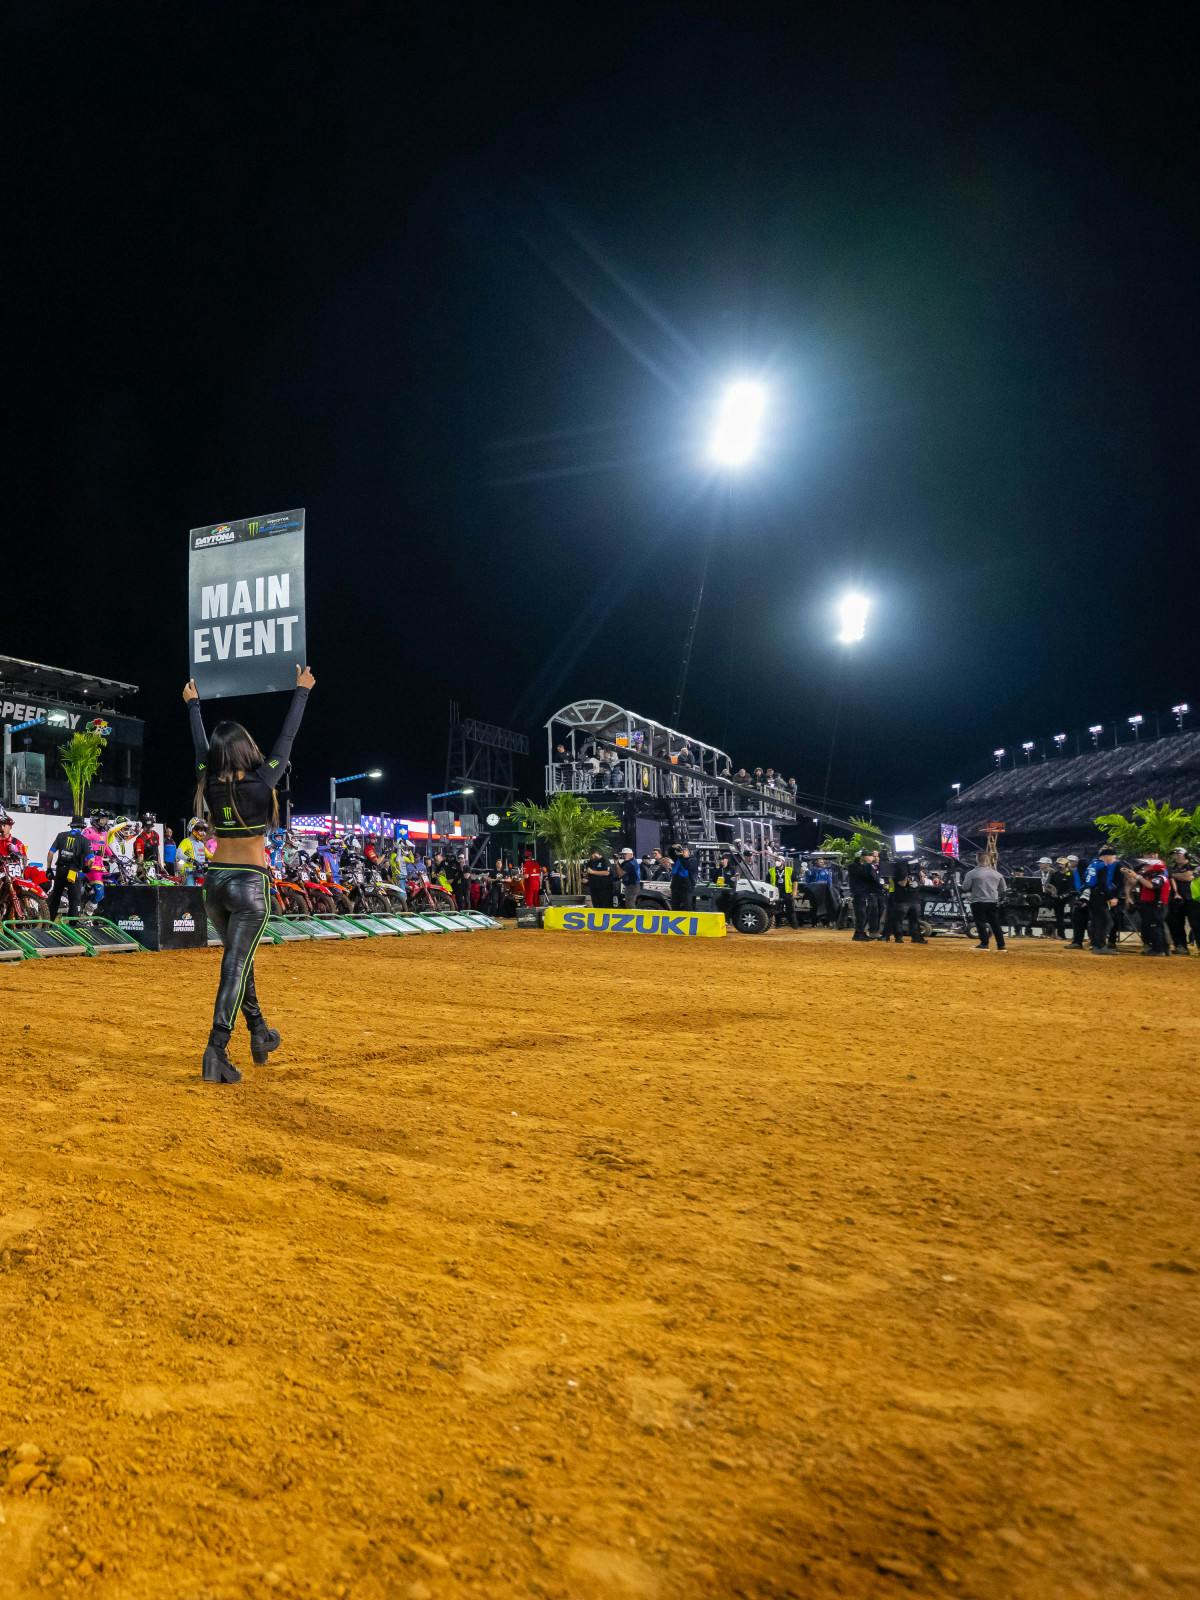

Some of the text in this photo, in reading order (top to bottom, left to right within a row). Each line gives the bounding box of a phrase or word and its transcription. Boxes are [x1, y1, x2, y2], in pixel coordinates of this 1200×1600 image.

[195, 532, 235, 546] DAYTONA
[201, 573, 290, 620] MAIN
[194, 615, 299, 664] EVENT
[562, 912, 699, 936] SUZUKI
